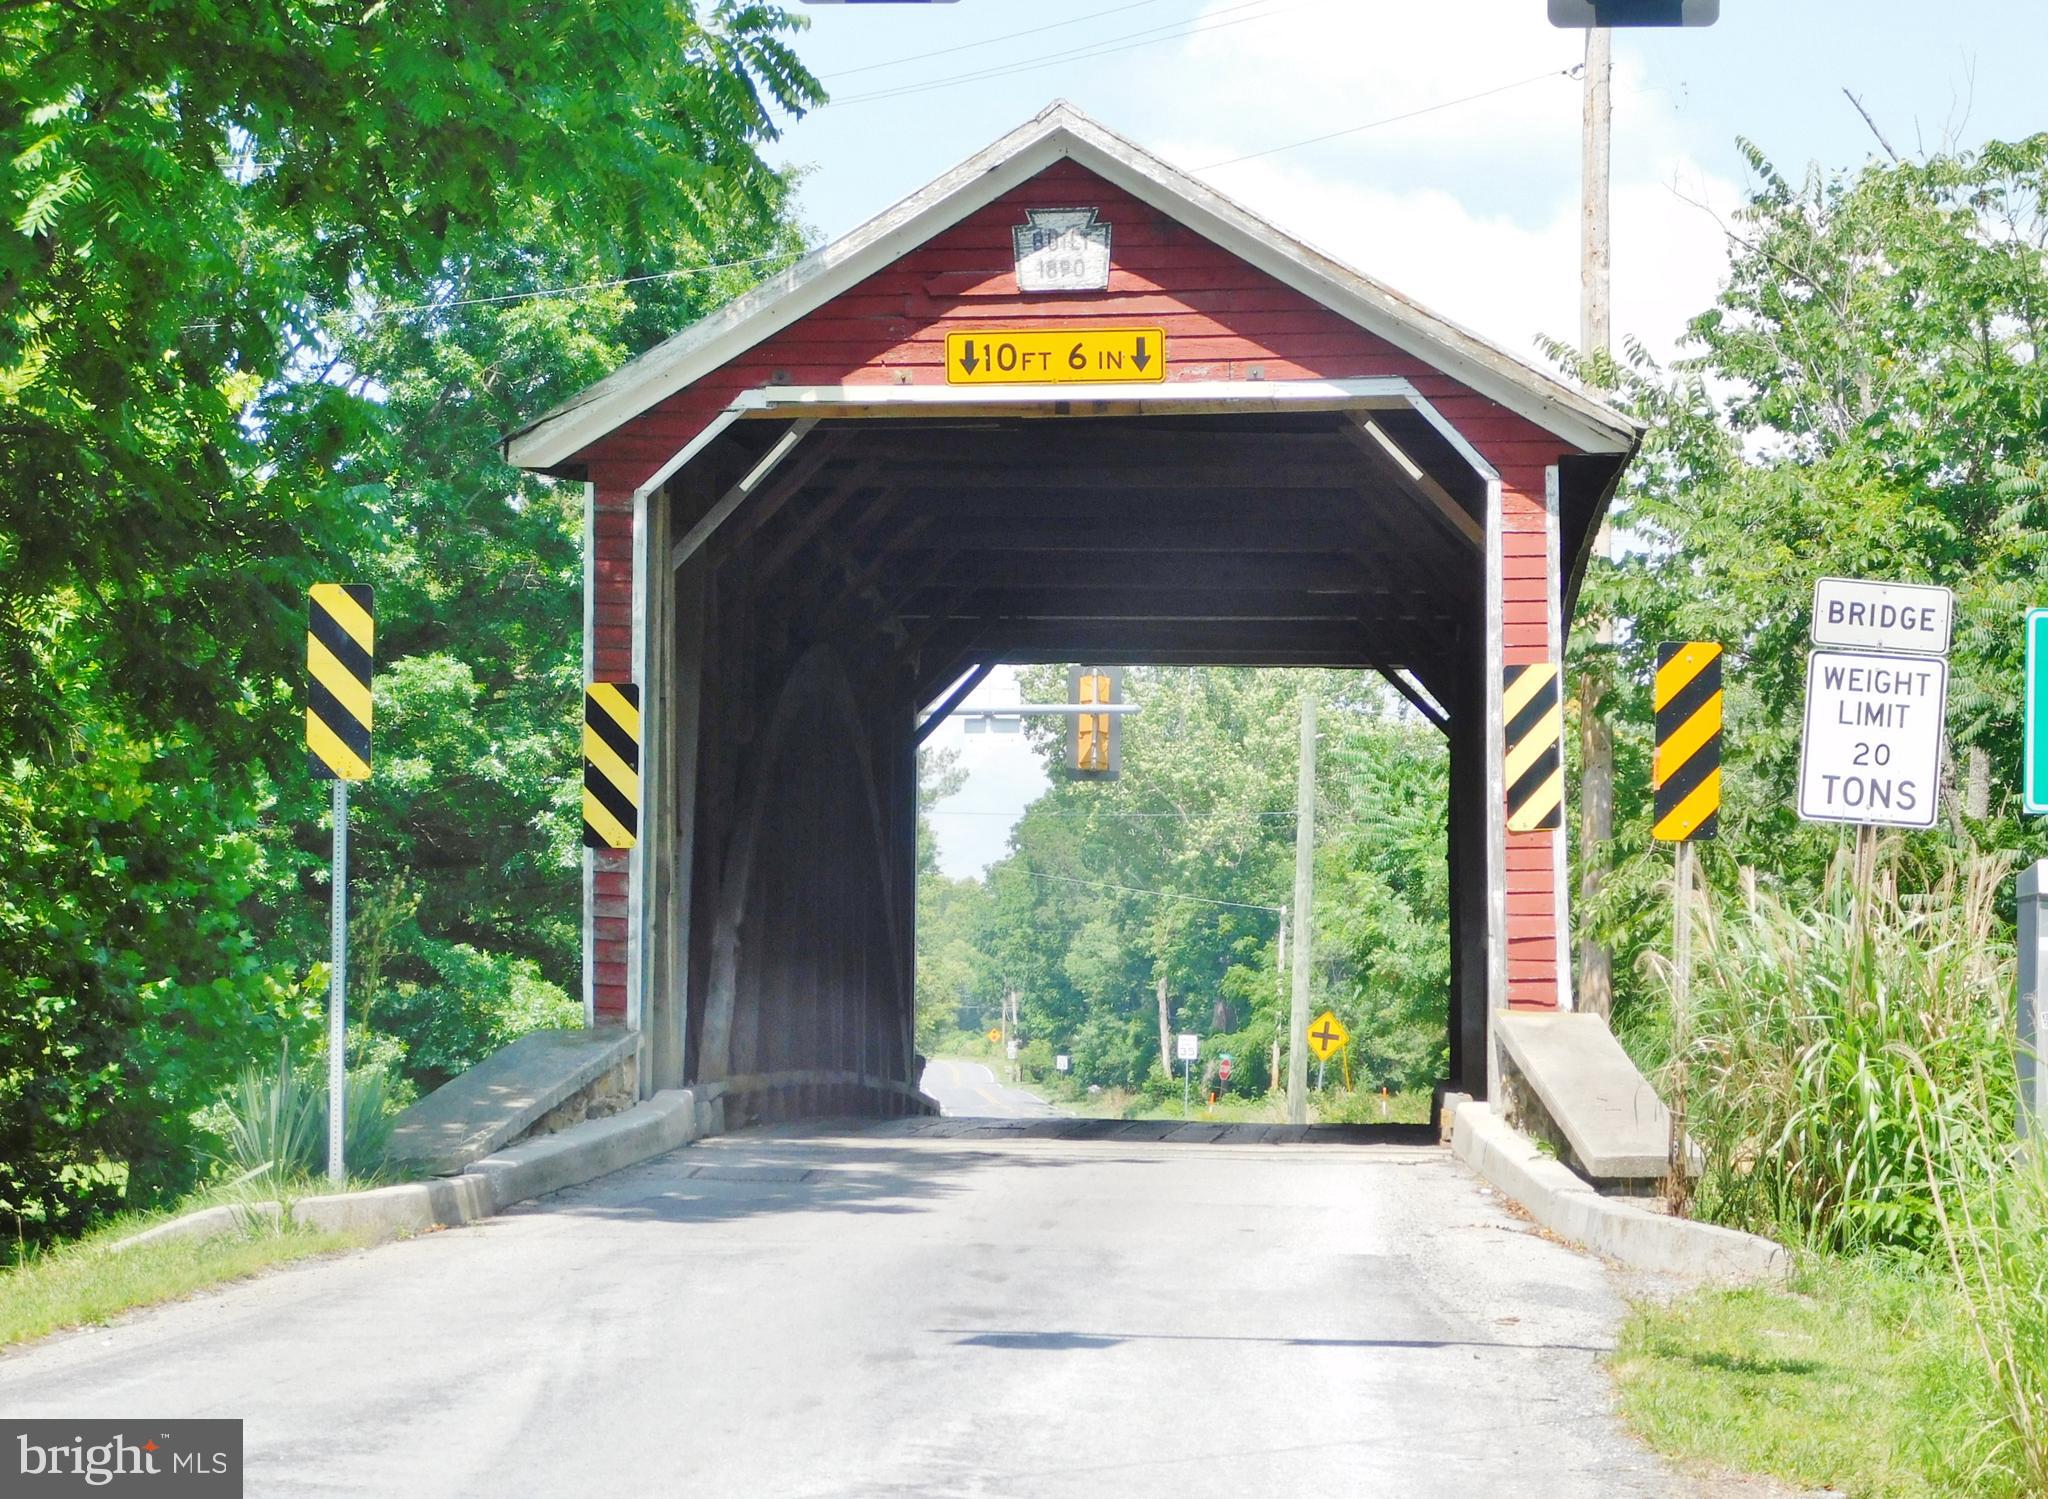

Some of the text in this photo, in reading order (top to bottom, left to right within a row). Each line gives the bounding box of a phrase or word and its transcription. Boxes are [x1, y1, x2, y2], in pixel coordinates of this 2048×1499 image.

[1033, 229, 1091, 251] BUILT
[1039, 258, 1085, 278] 1890
[1068, 342, 1088, 370] 6
[1098, 350, 1122, 369] IN
[1828, 600, 1936, 632] BRIDGE
[1824, 666, 1931, 696] WEIGHT
[1838, 700, 1910, 729] LIMIT
[1852, 742, 1890, 766] 20
[1822, 774, 1916, 811] TONS
[1180, 1047, 1195, 1056] 35
